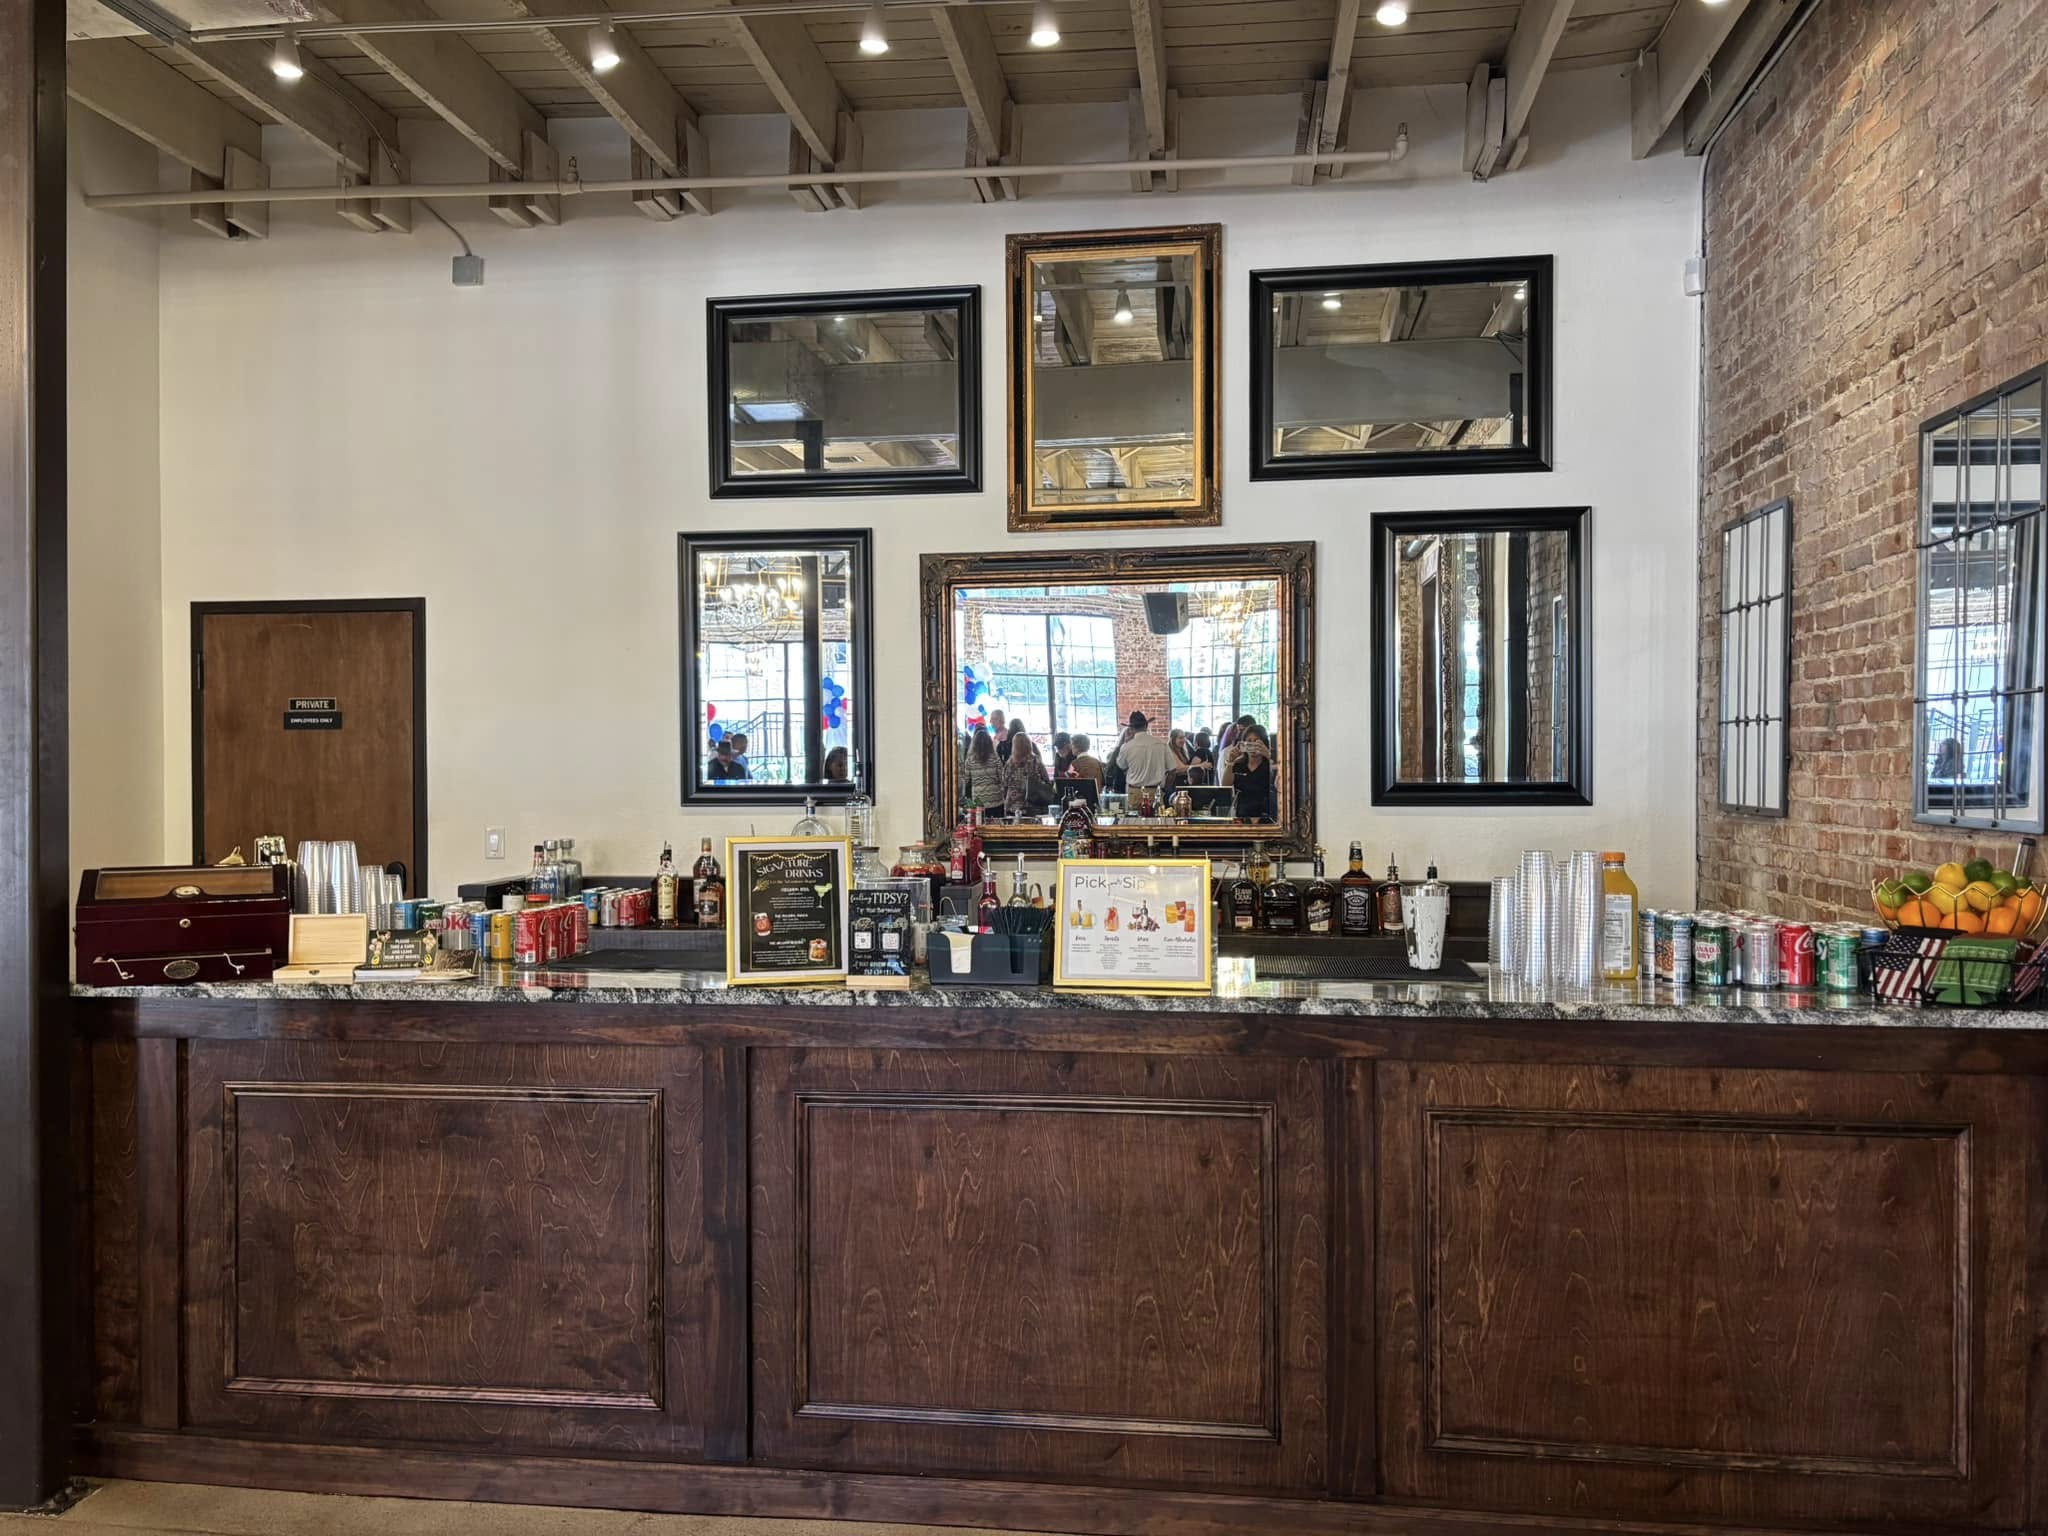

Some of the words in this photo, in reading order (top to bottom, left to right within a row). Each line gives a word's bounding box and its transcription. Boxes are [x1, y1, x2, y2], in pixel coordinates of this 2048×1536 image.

[295, 700, 330, 709] PRIVATE
[756, 859, 813, 877] SIGNATURE
[785, 868, 824, 878] DRINKS
[1075, 876, 1107, 889] Pick
[1122, 876, 1146, 890] Sip
[871, 892, 909, 905] TIPSY?
